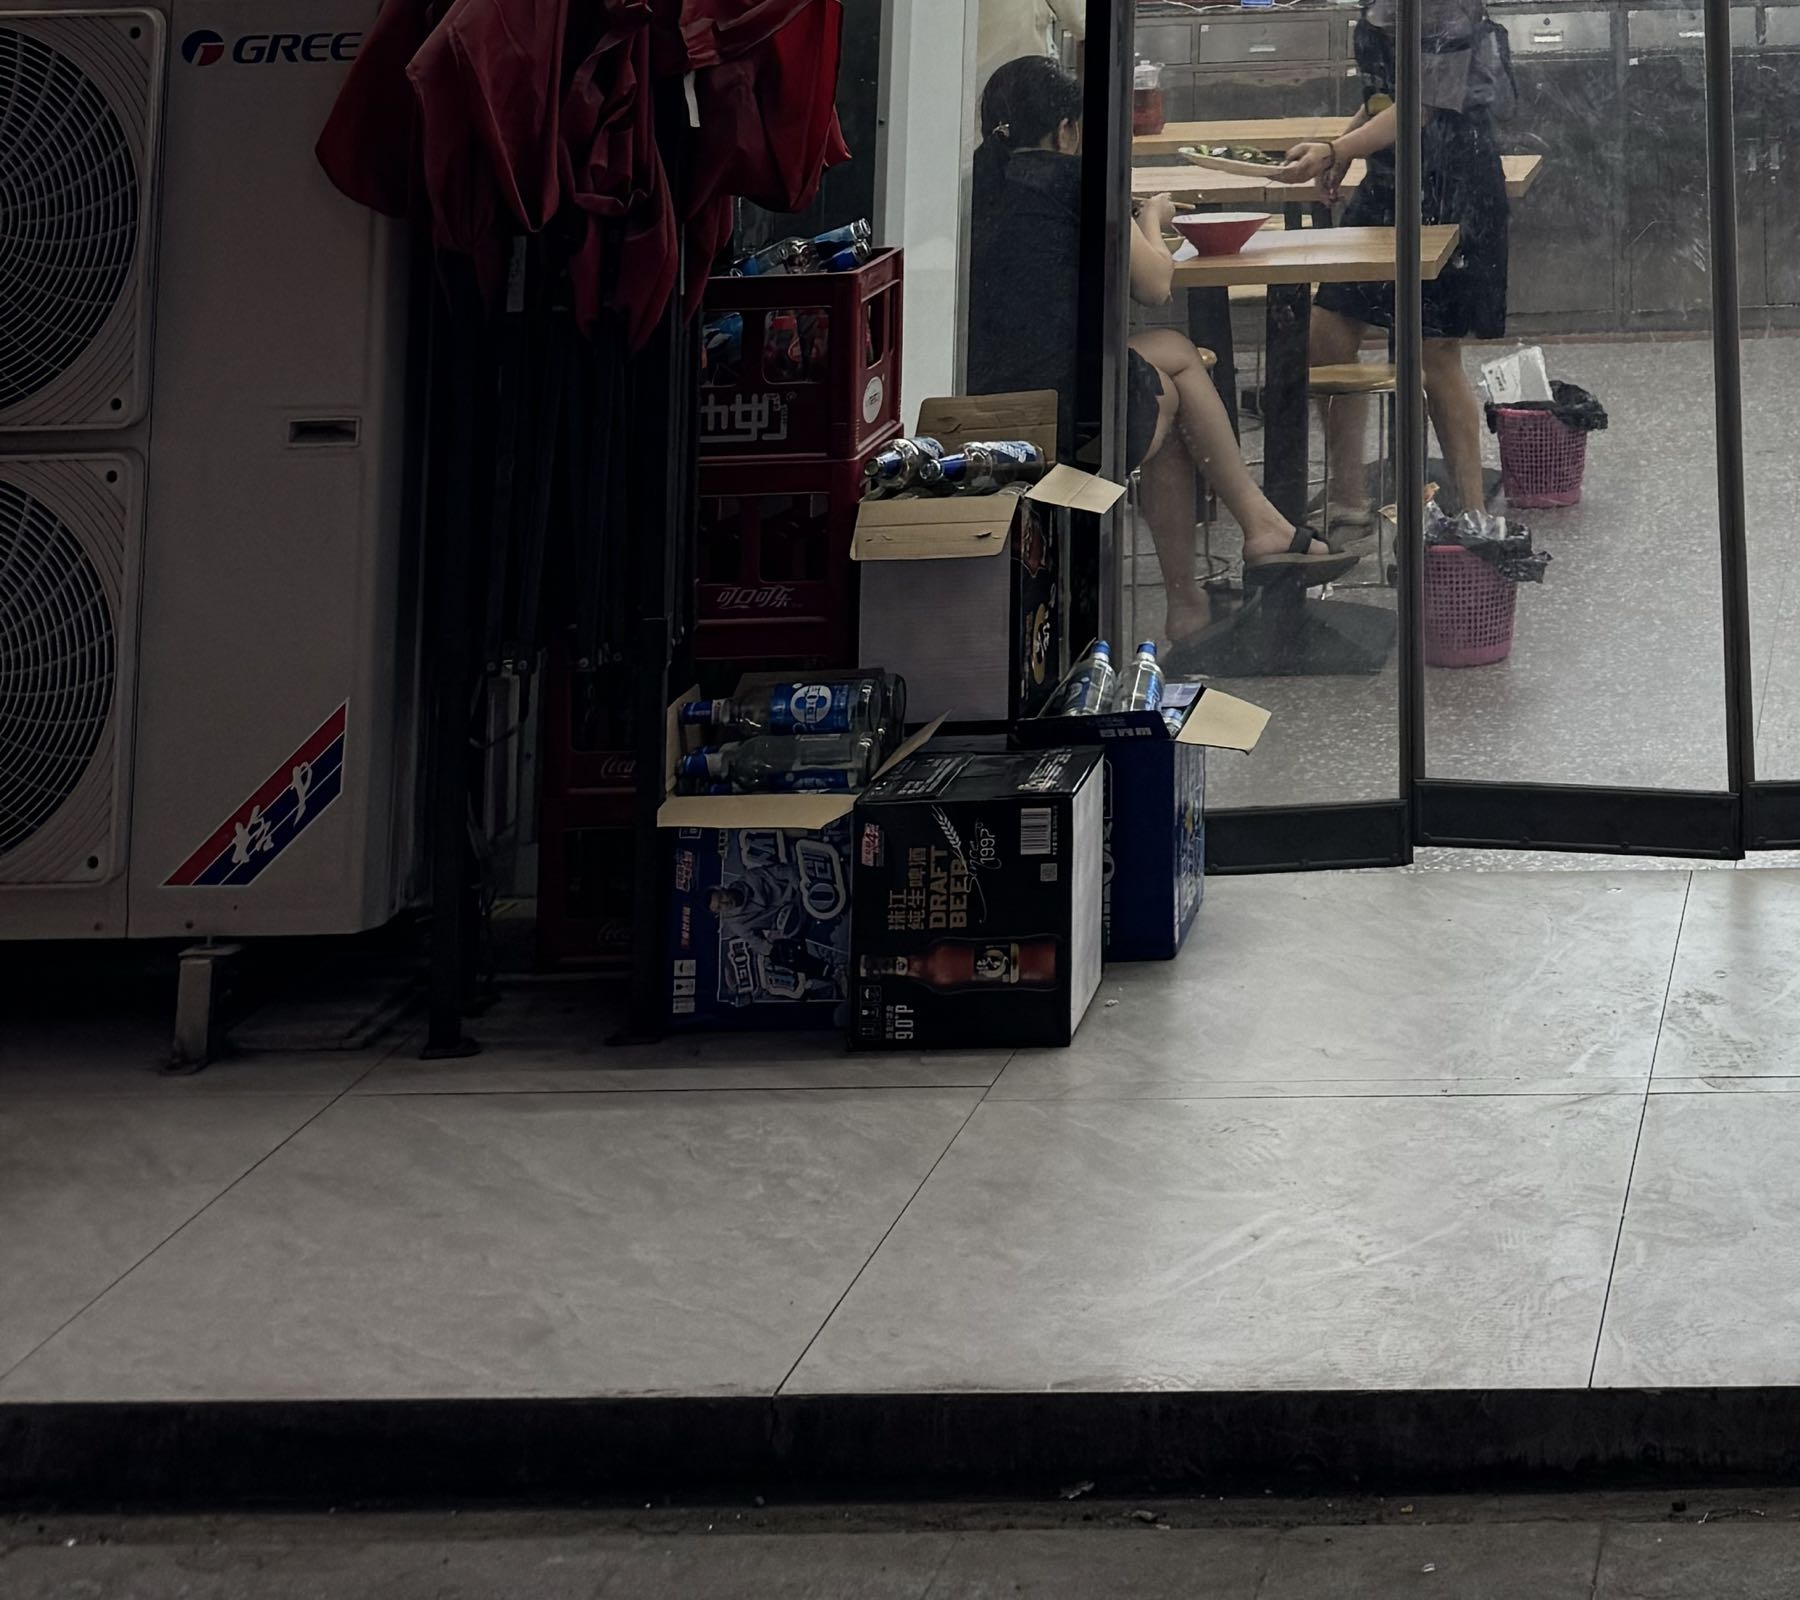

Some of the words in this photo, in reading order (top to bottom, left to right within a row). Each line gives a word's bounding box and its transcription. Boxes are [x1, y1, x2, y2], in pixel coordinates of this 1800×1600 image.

[234, 32, 362, 63] GREE
[928, 845, 950, 930] DRAFT
[949, 856, 969, 930] BEER
